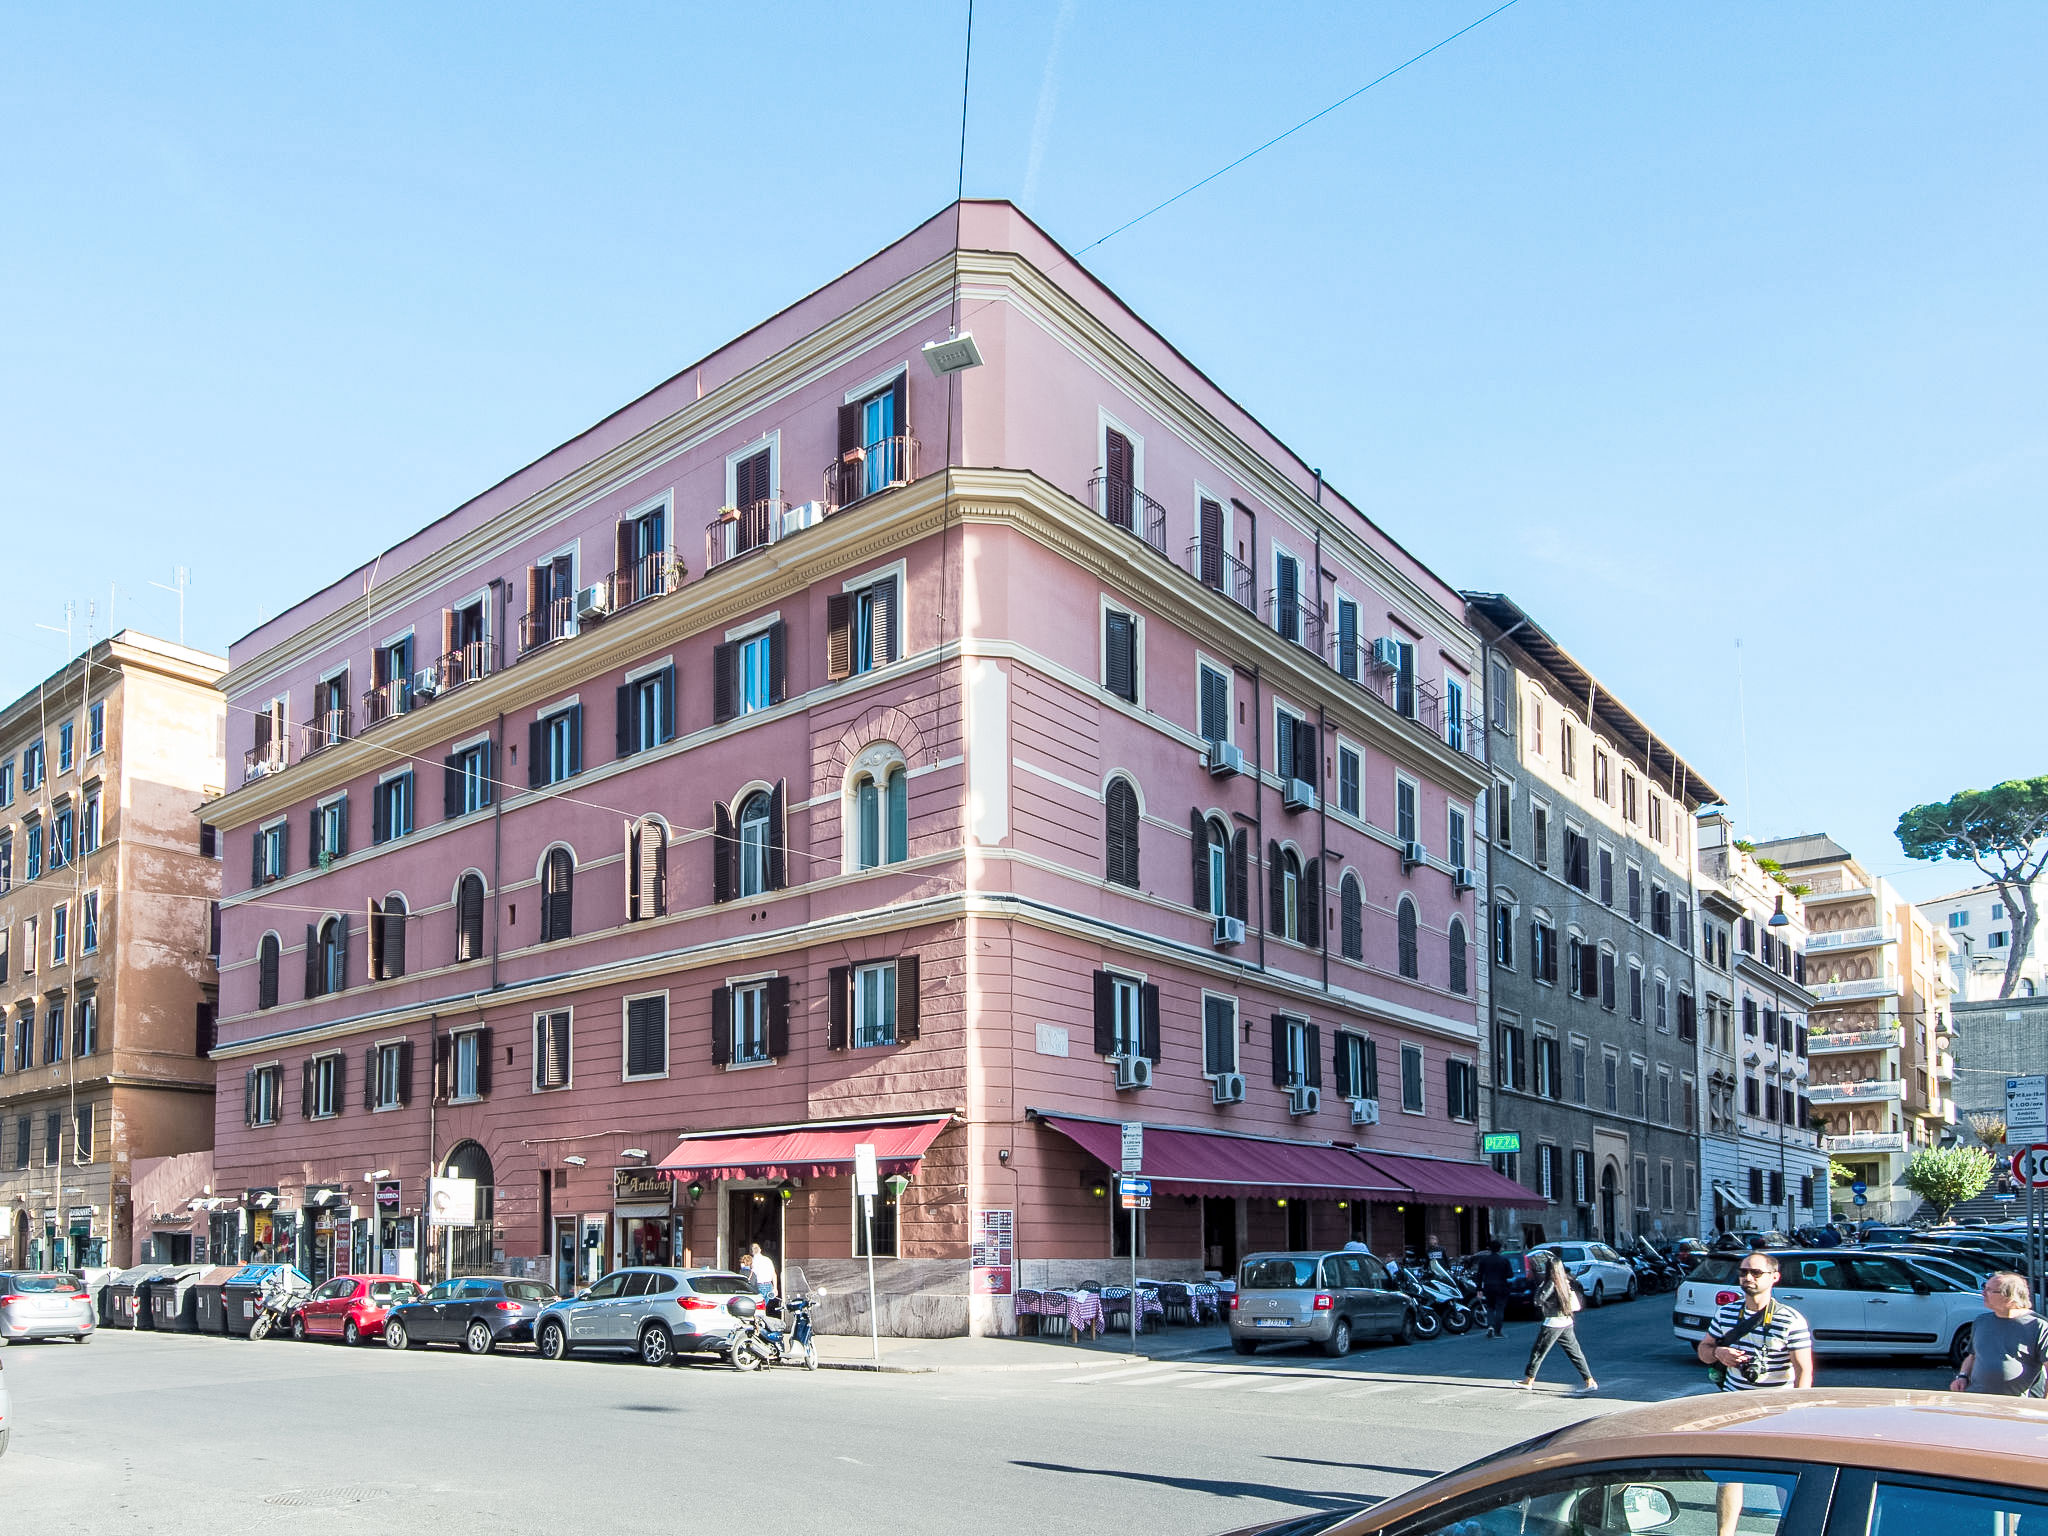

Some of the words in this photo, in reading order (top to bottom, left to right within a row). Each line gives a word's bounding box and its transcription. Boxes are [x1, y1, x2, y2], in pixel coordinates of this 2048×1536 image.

[1486, 1136, 1520, 1149] PIZZA
[614, 1171, 629, 1186] Sir
[629, 1176, 672, 1195] Anthony
